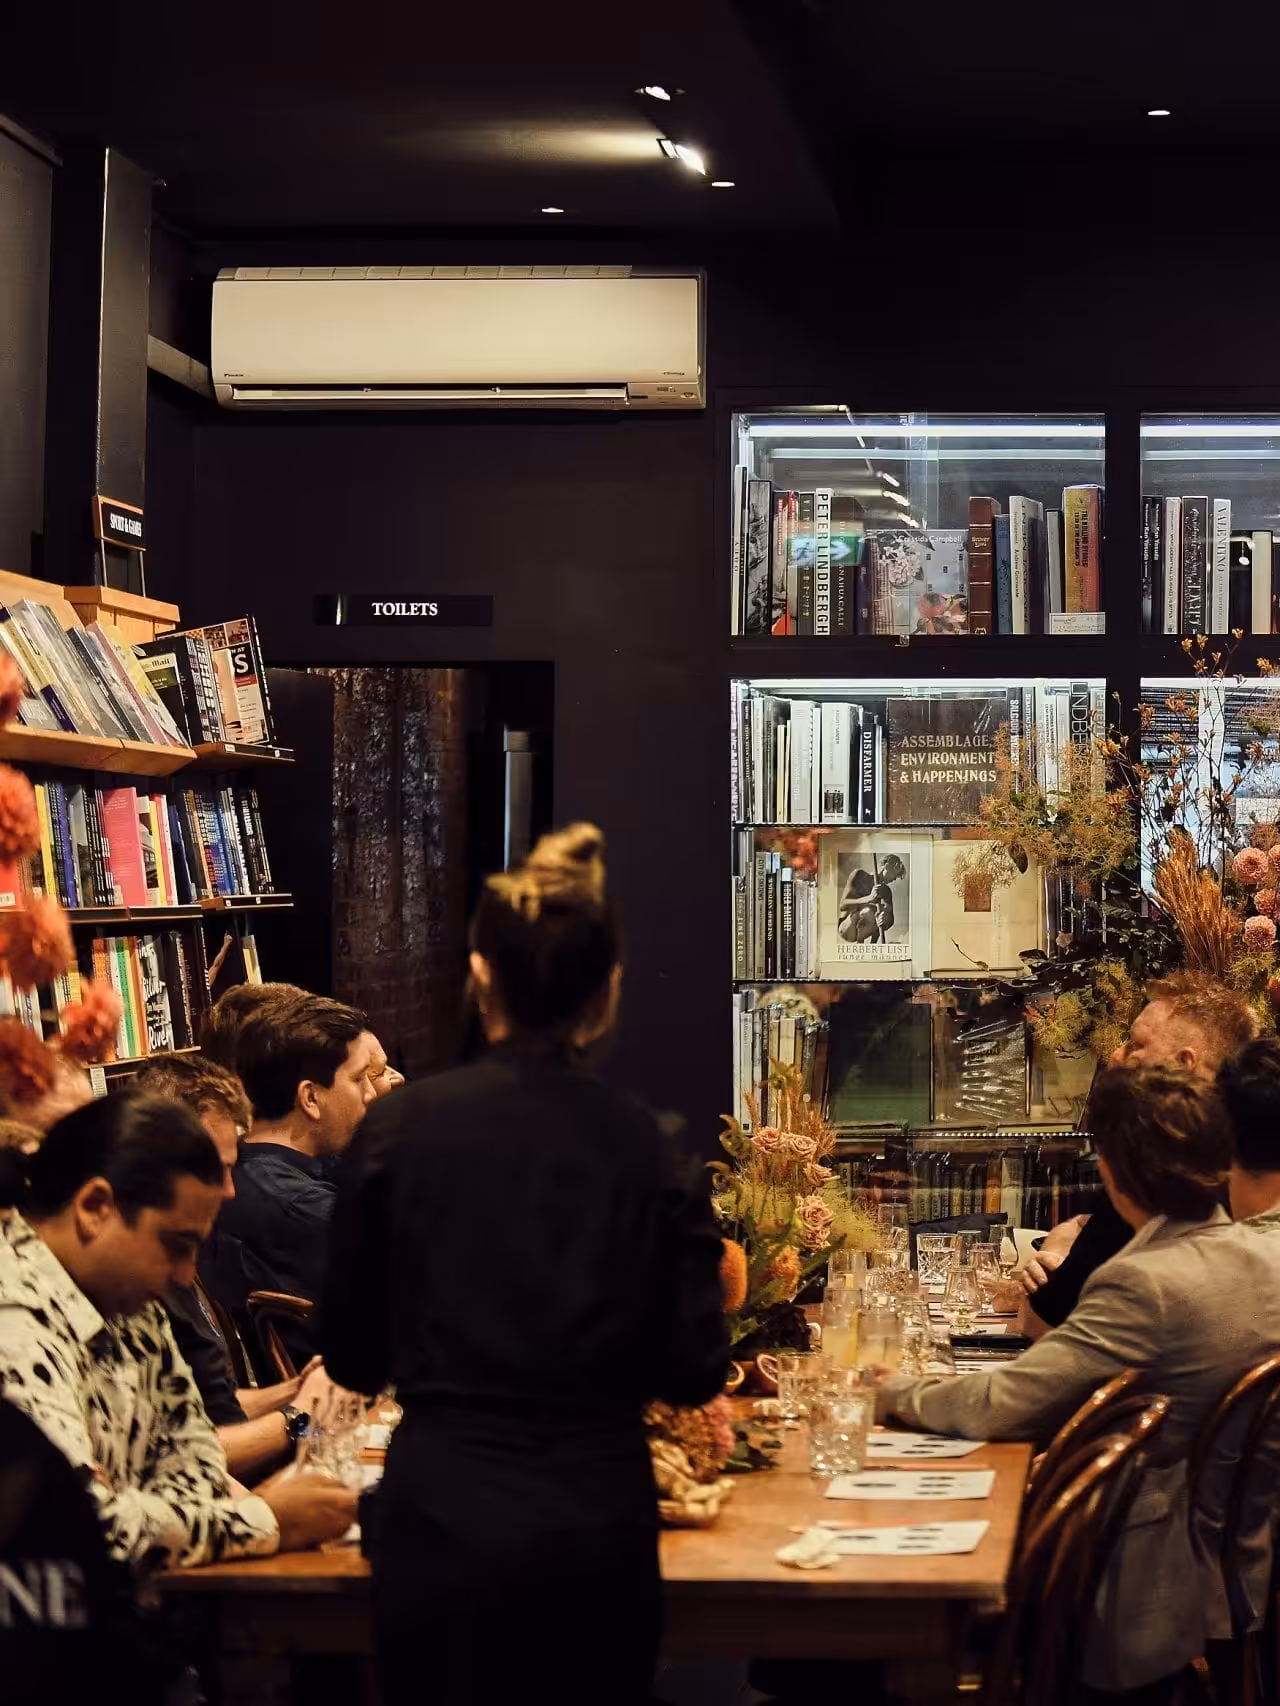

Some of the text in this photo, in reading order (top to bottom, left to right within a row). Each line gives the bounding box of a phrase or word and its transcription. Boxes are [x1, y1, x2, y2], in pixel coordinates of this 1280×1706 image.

[929, 535, 962, 543] Campbell
[1217, 507, 1227, 572] VALENTINO
[817, 493, 829, 633] PETER LINDBERGH
[371, 602, 438, 616] TOILETS
[1010, 699, 1019, 734] SALGADO
[901, 735, 993, 749] ASSEMBLAGE,
[863, 731, 872, 793] DISFARMER
[900, 769, 997, 783] & HAPPENINGS
[837, 945, 910, 954] HERBERT LIST
